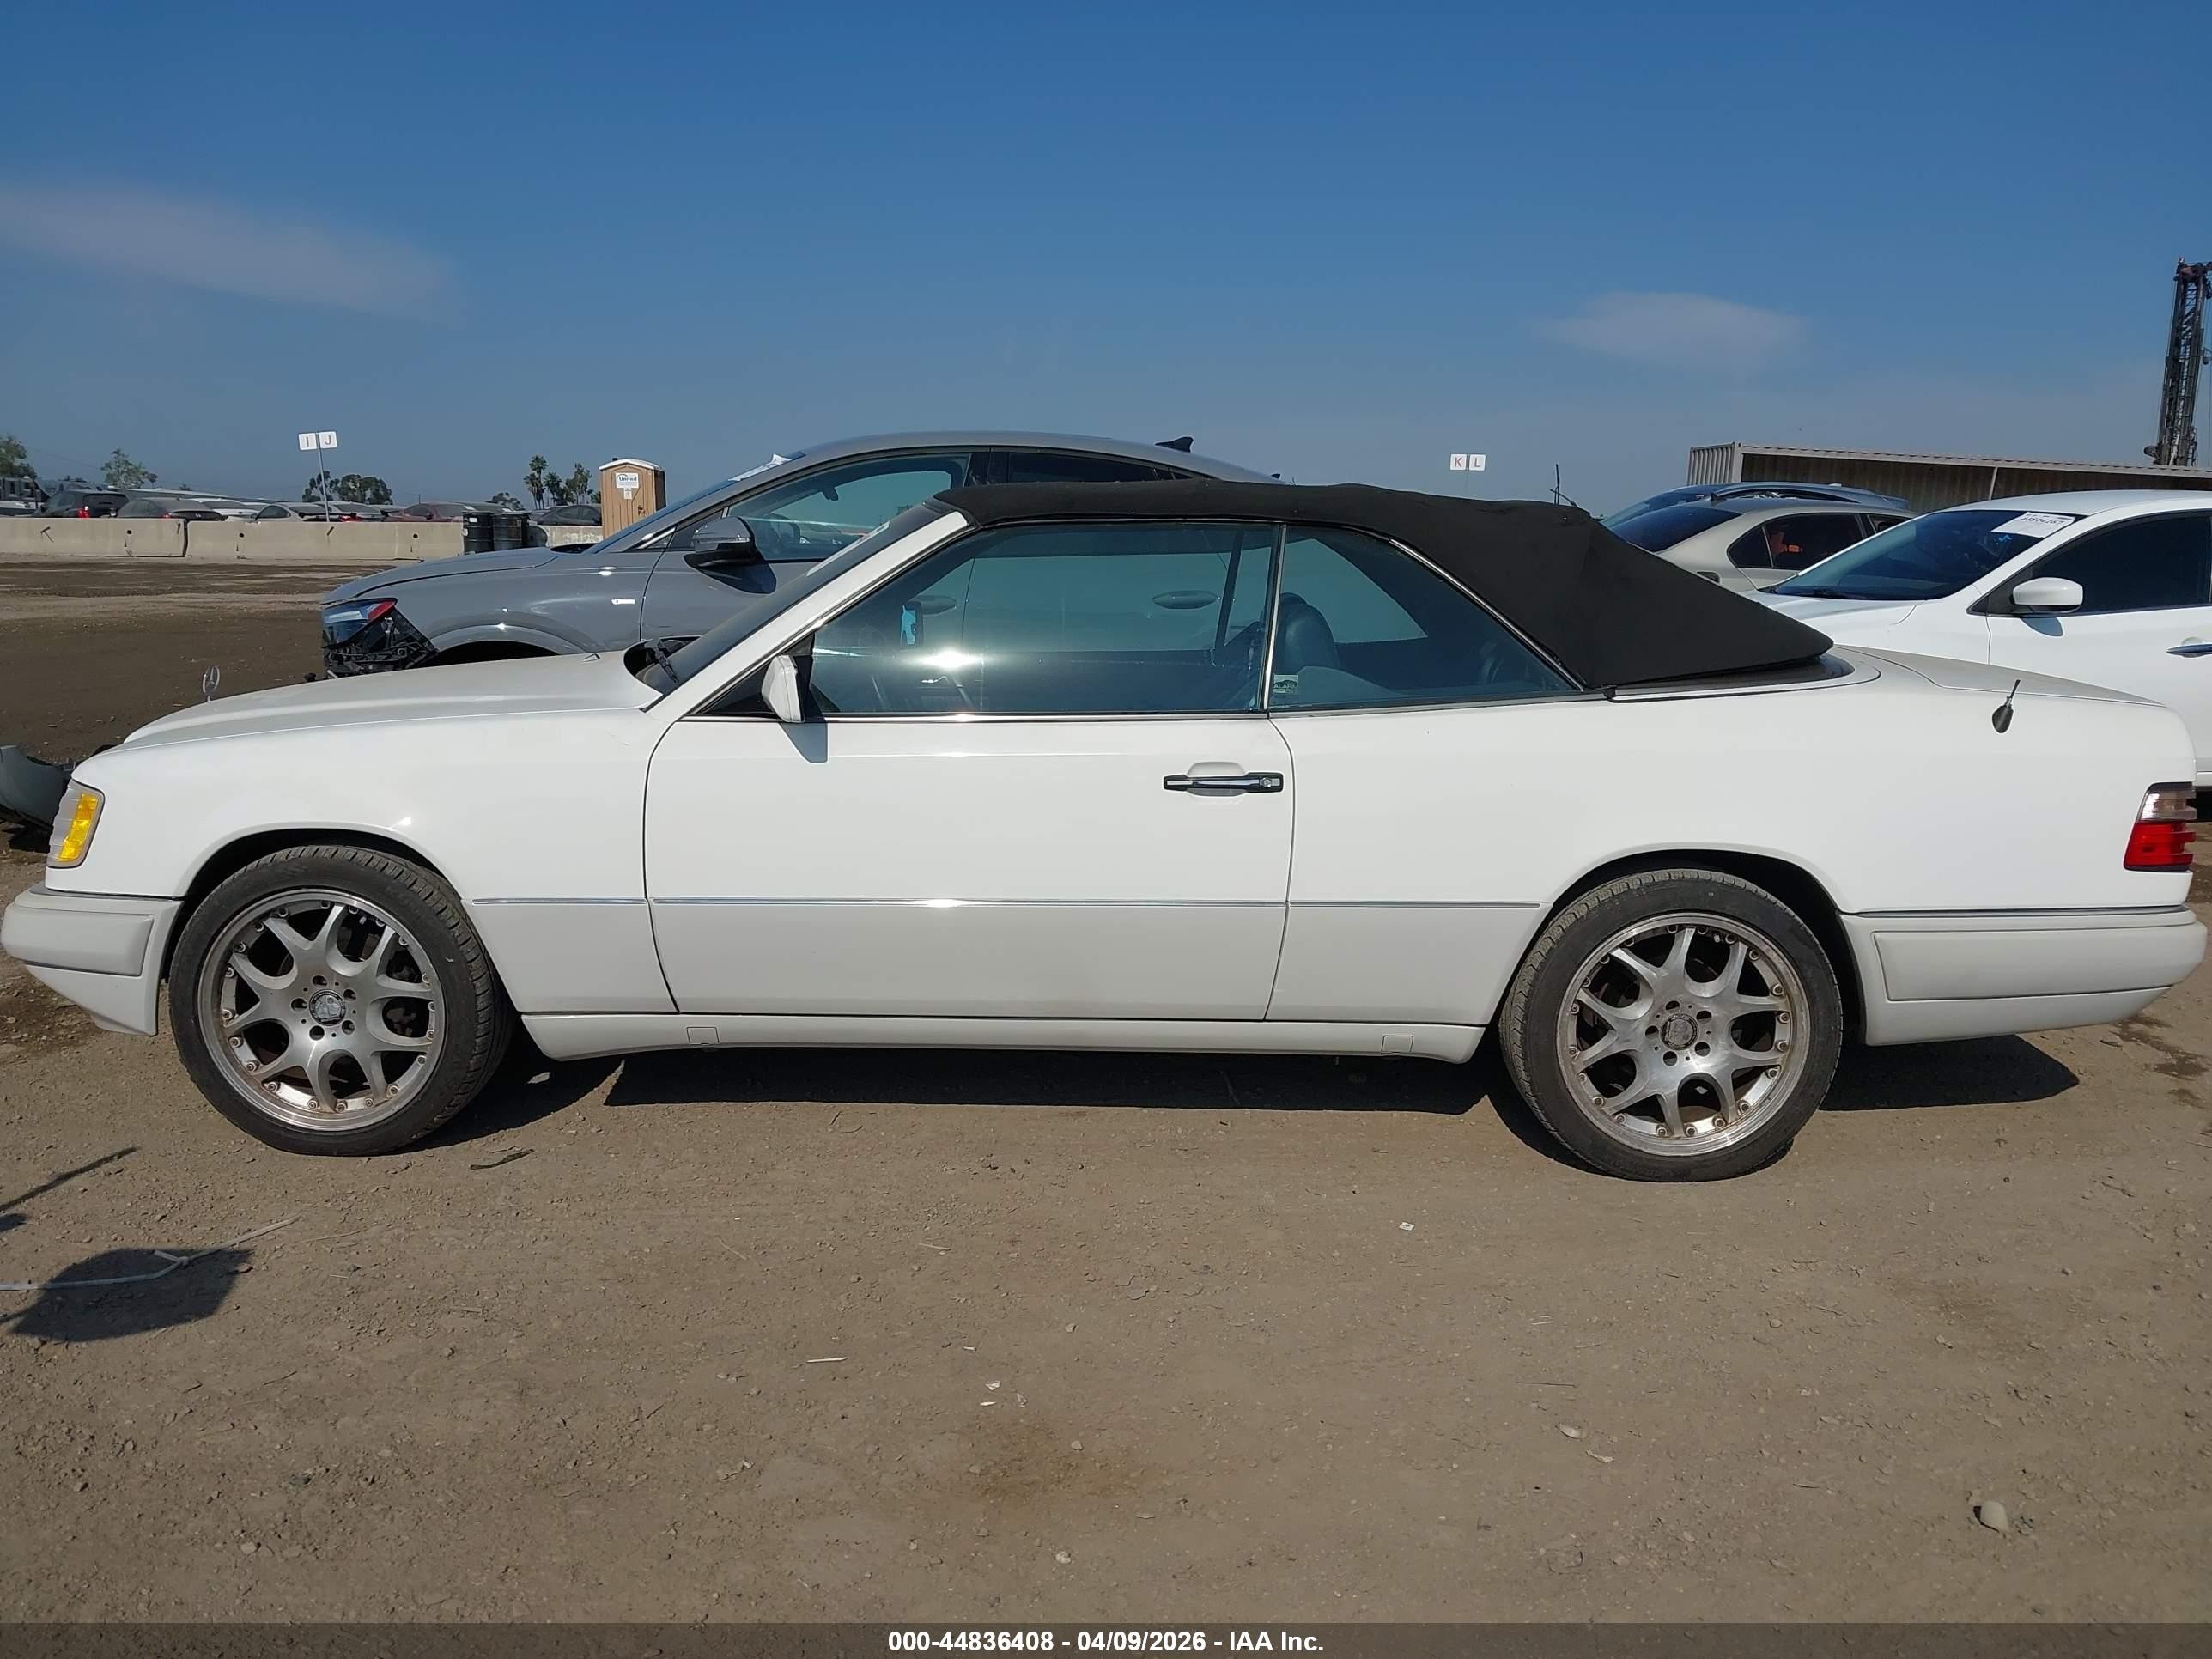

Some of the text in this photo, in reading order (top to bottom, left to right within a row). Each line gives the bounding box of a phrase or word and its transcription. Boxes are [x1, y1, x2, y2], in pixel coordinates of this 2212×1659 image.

[324, 434, 331, 445] J
[1454, 457, 1481, 468] K L
